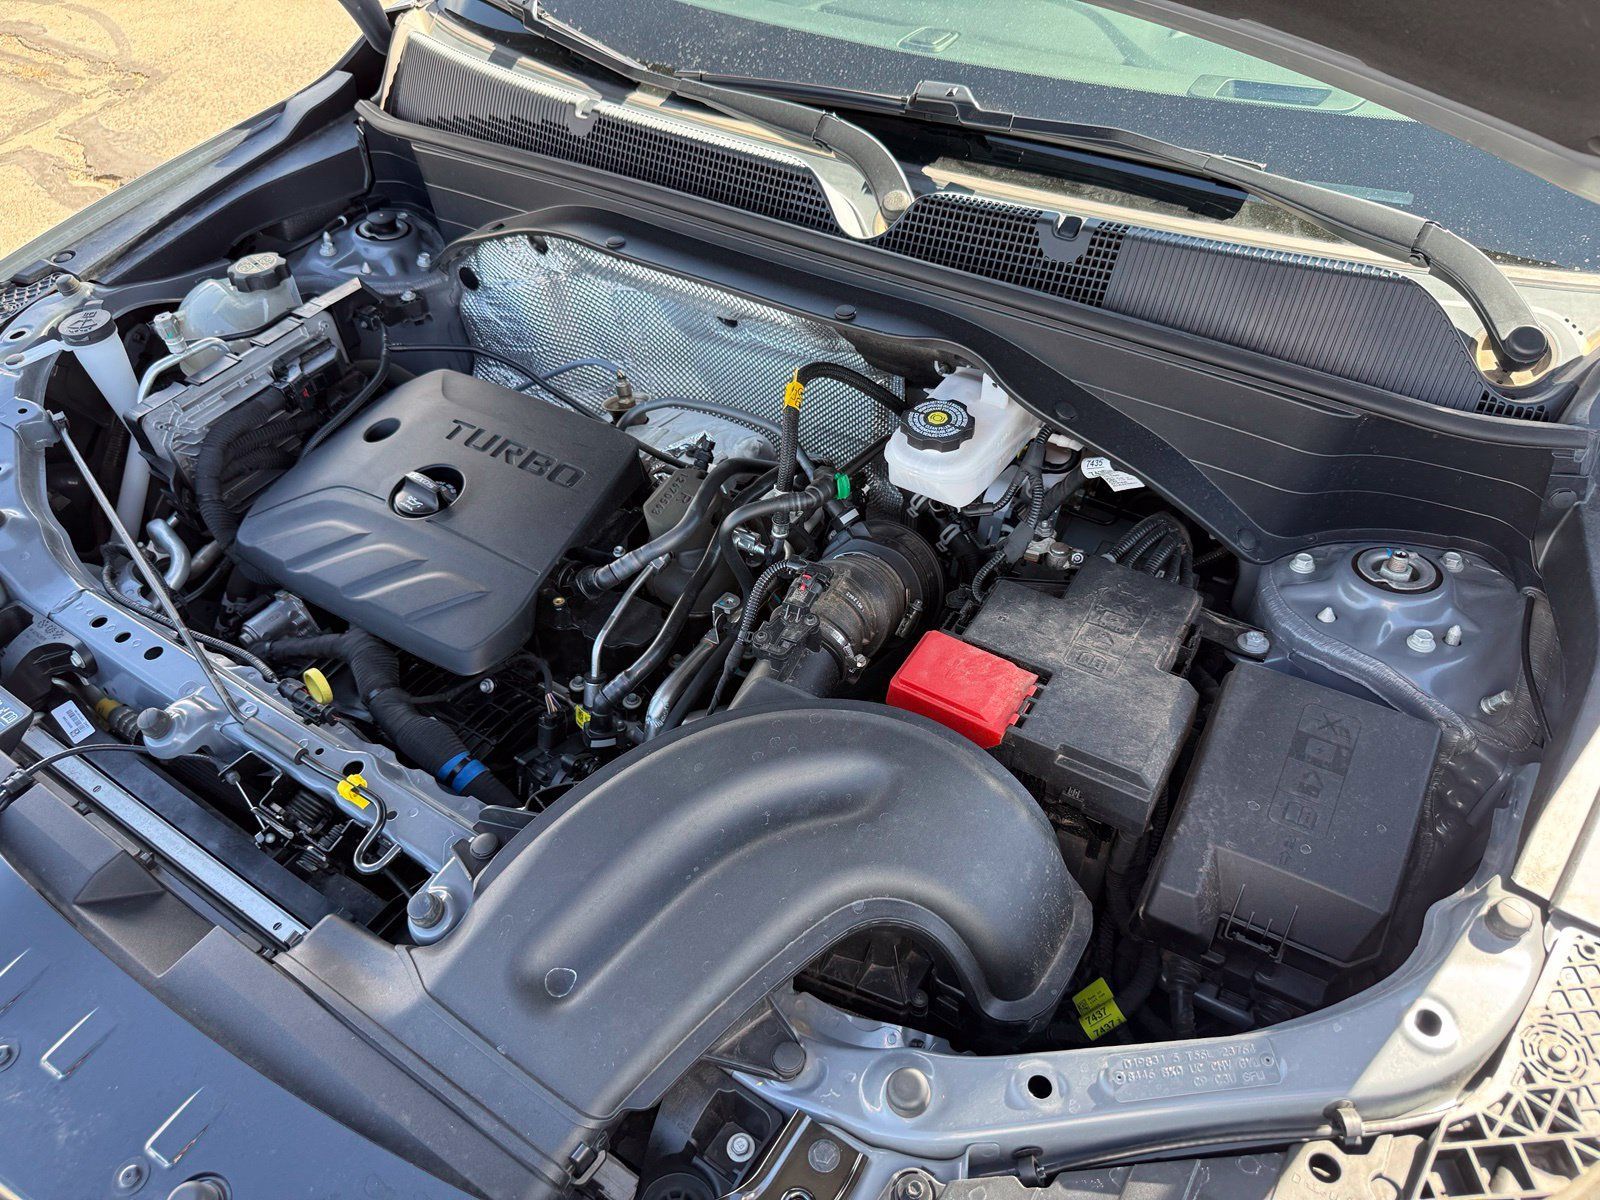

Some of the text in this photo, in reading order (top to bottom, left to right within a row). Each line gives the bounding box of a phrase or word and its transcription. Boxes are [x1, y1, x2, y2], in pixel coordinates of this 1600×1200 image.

[445, 419, 587, 489] TURBO
[1086, 459, 1104, 467] 7435
[1085, 1006, 1107, 1025] 7437
